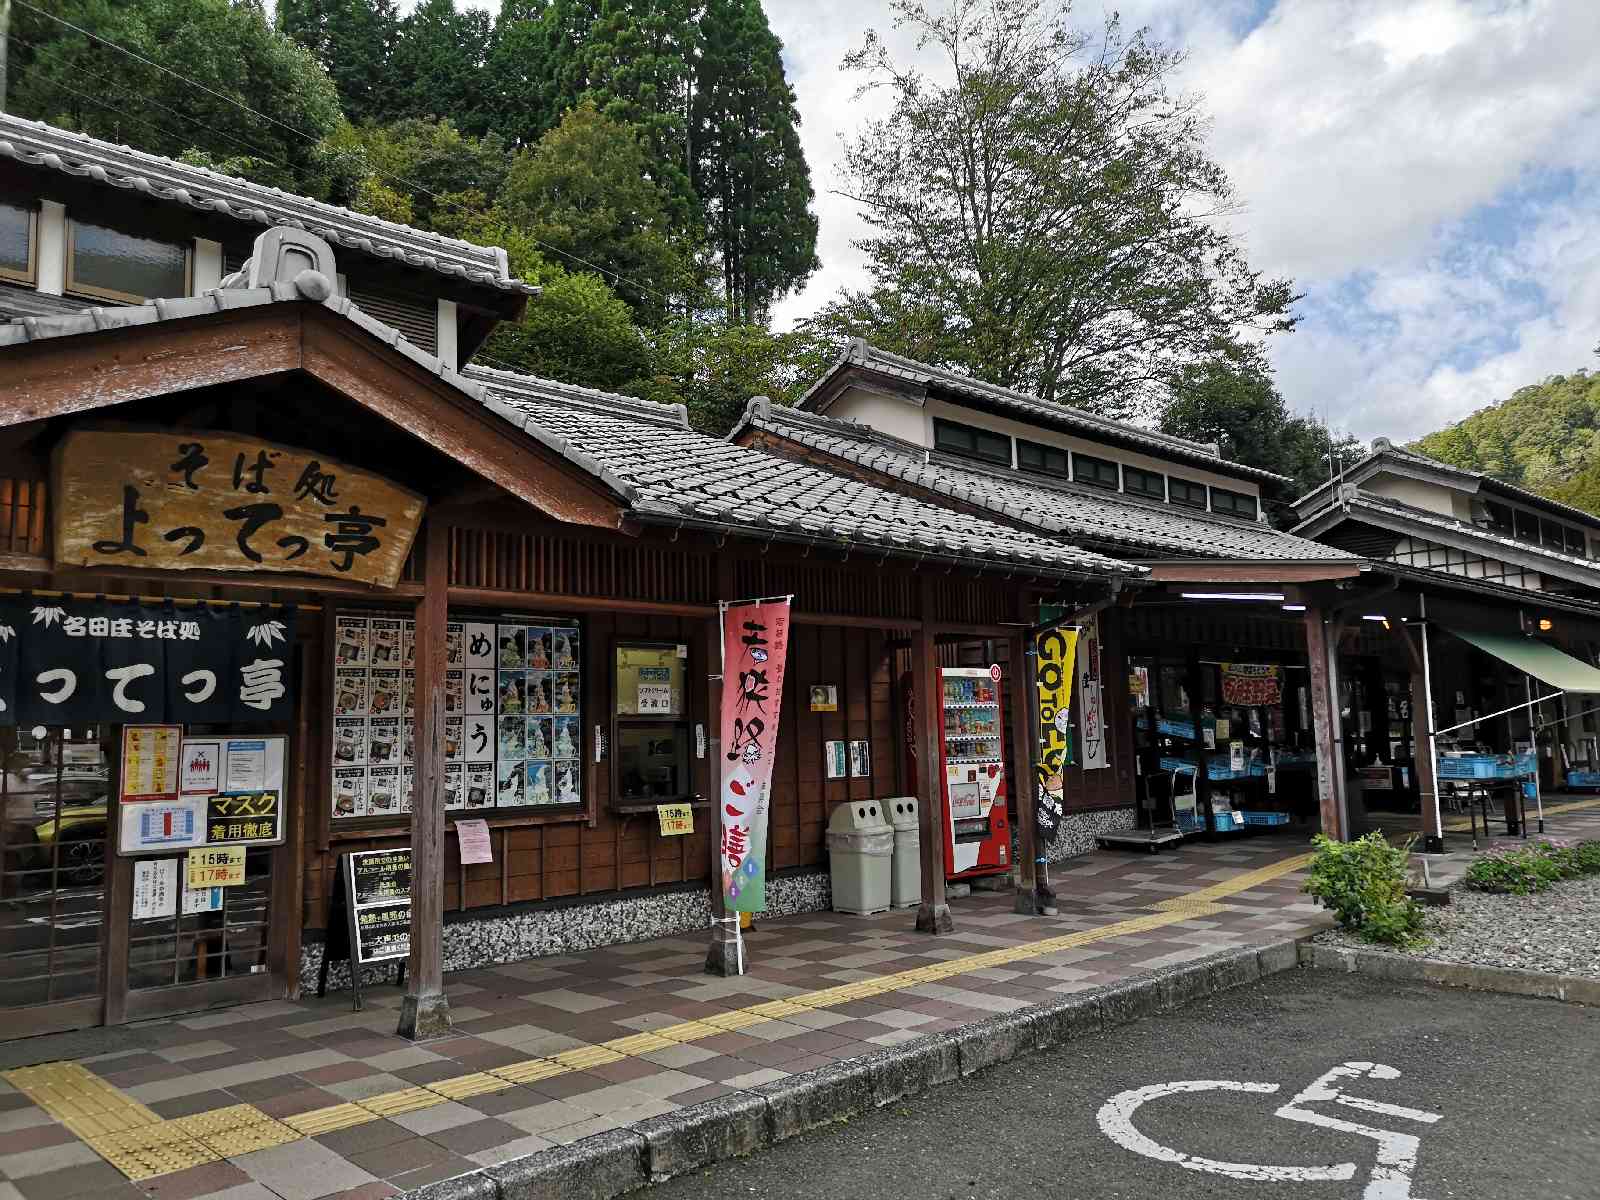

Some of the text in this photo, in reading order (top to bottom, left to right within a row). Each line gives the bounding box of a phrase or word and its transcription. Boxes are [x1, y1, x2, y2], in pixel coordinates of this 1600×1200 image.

[171, 442, 339, 506] そば処
[92, 485, 387, 572] よってっ亭
[63, 616, 201, 641] 名田庄そば処
[0, 658, 286, 713] ってっ亭
[470, 631, 494, 754] めにゅう
[211, 792, 276, 816] マスク
[211, 821, 274, 840] 着用徹底
